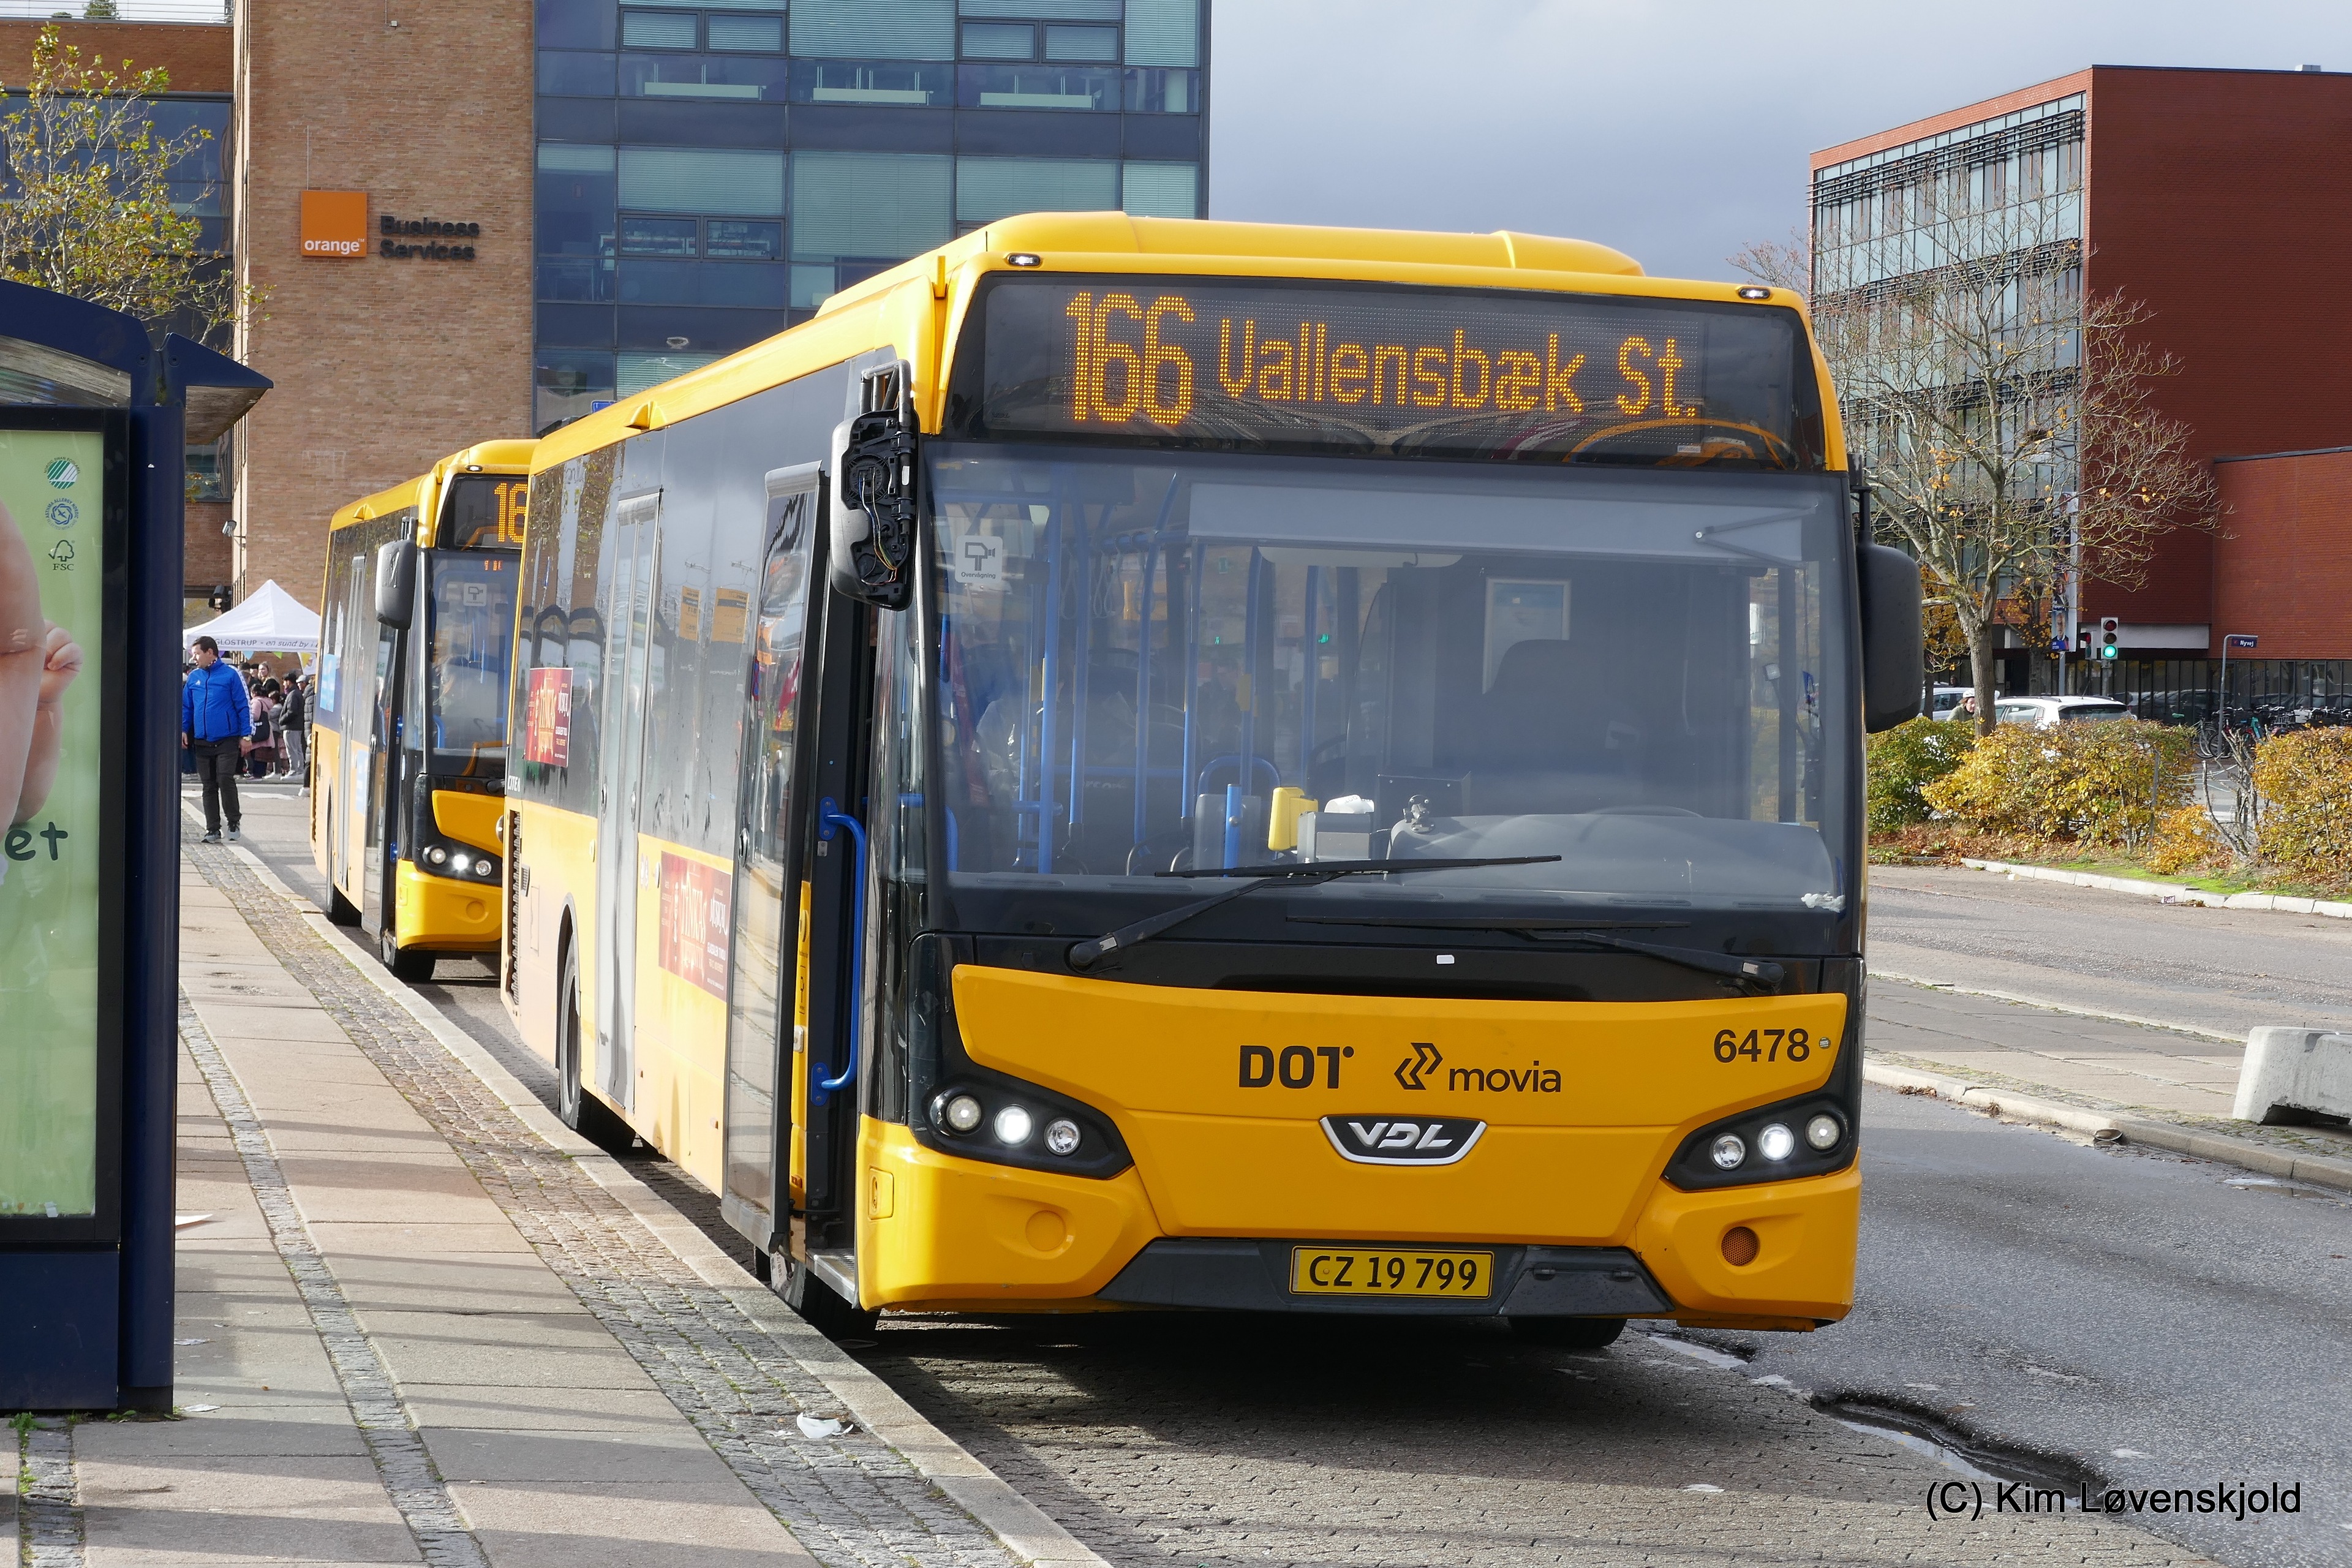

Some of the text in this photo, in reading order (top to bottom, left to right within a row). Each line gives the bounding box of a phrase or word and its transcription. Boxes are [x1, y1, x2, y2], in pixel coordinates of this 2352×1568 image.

[380, 216, 480, 237] Business
[304, 239, 360, 255] orange
[379, 238, 475, 260] Services
[1065, 292, 1696, 425] 166 Vallensbæk St.
[507, 775, 520, 792] CITEA
[1713, 1028, 1810, 1063] 6478
[1238, 1045, 1561, 1093] DOT movia
[1348, 1122, 1453, 1150] VDL
[1310, 1255, 1478, 1291] CZ 19 799
